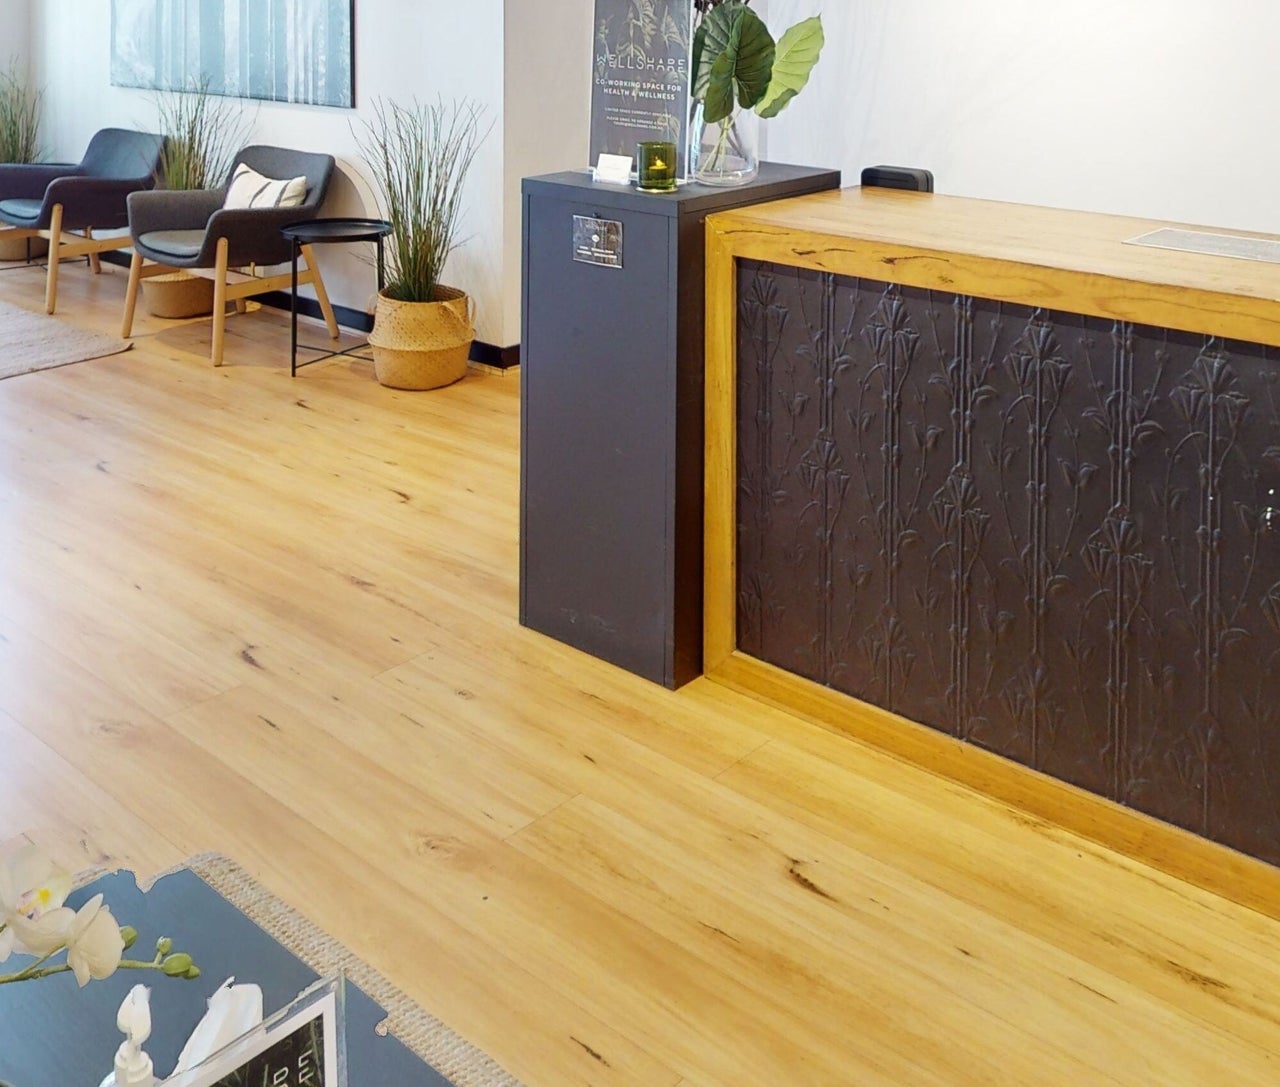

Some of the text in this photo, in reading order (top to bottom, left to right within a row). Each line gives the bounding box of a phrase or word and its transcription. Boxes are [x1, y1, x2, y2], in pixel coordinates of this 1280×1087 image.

[597, 54, 685, 72] WELLSHARE
[595, 79, 682, 92] CO-WORKING SPACE FOR
[603, 87, 630, 96] HEALTH
[639, 91, 675, 100] WELLNESS
